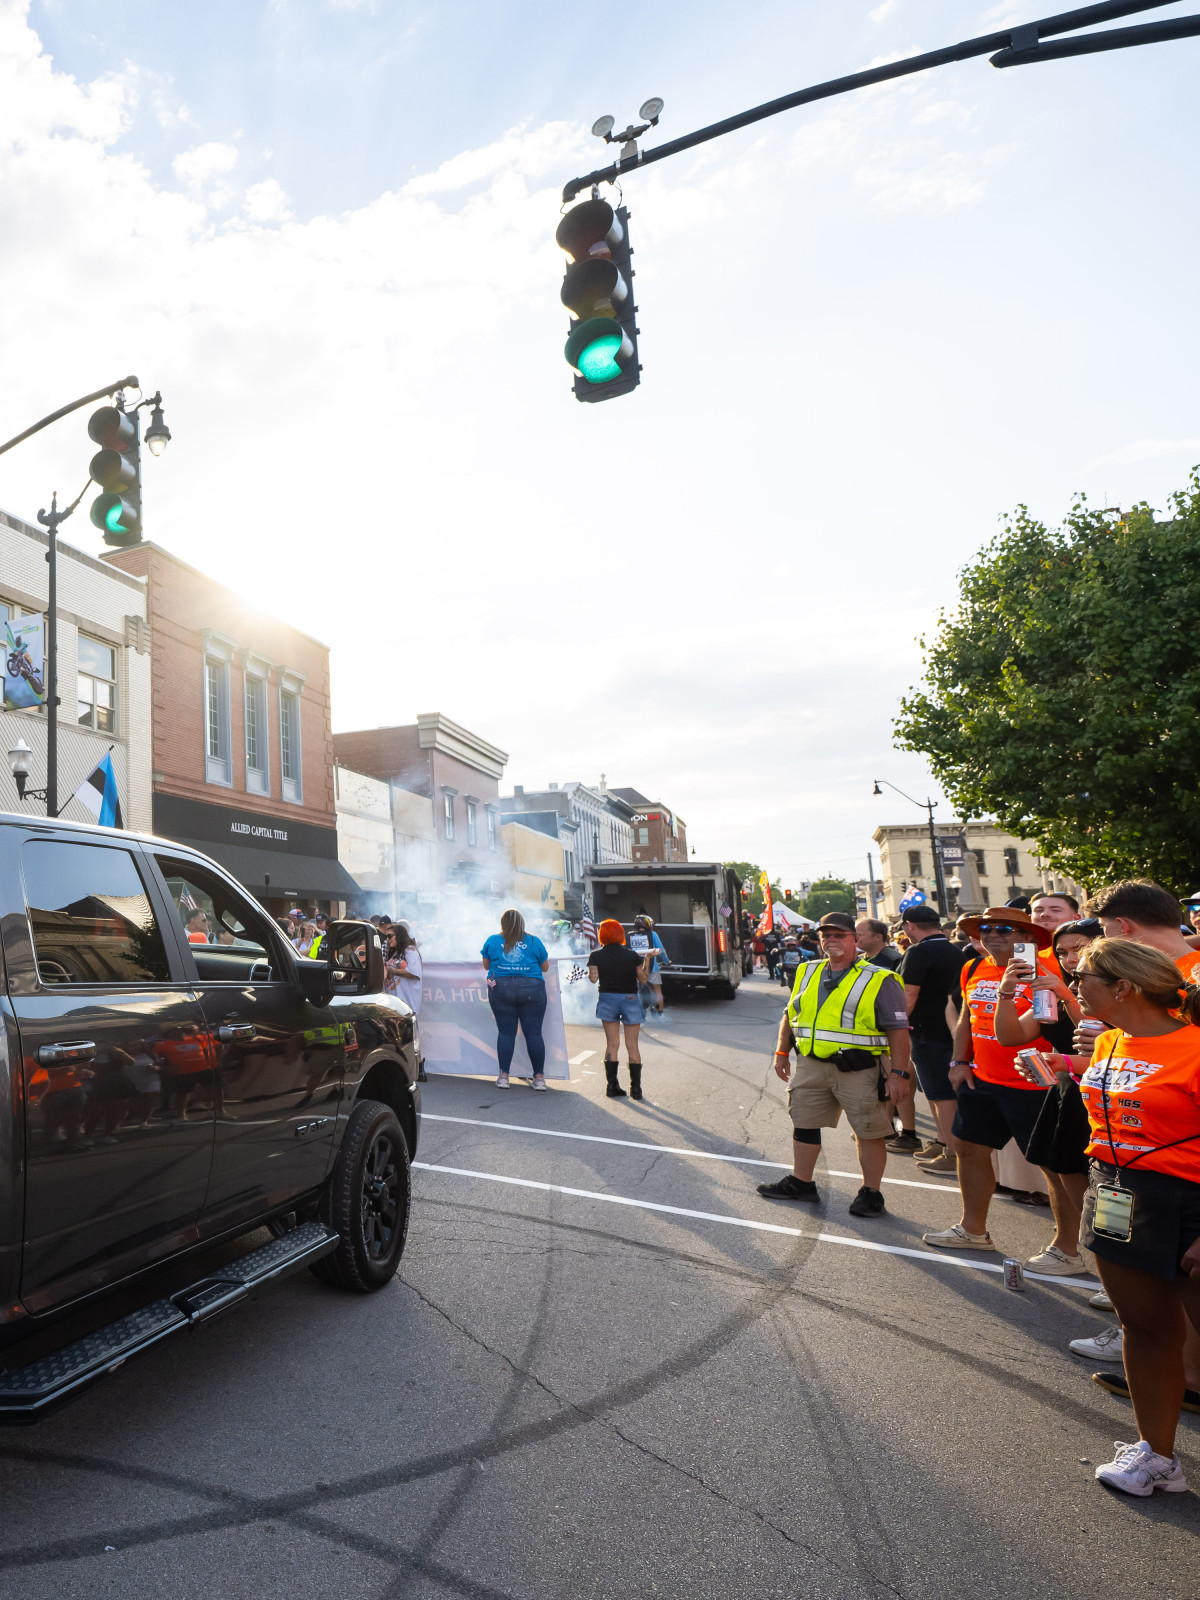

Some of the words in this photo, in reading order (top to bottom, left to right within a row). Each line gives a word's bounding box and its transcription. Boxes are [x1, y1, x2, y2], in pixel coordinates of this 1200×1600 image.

[230, 821, 251, 835] ALLIED
[251, 825, 273, 839] CAPITAL
[273, 829, 288, 841] TITLE
[1118, 1098, 1142, 1109] HGS
[295, 1118, 328, 1137] RAM
